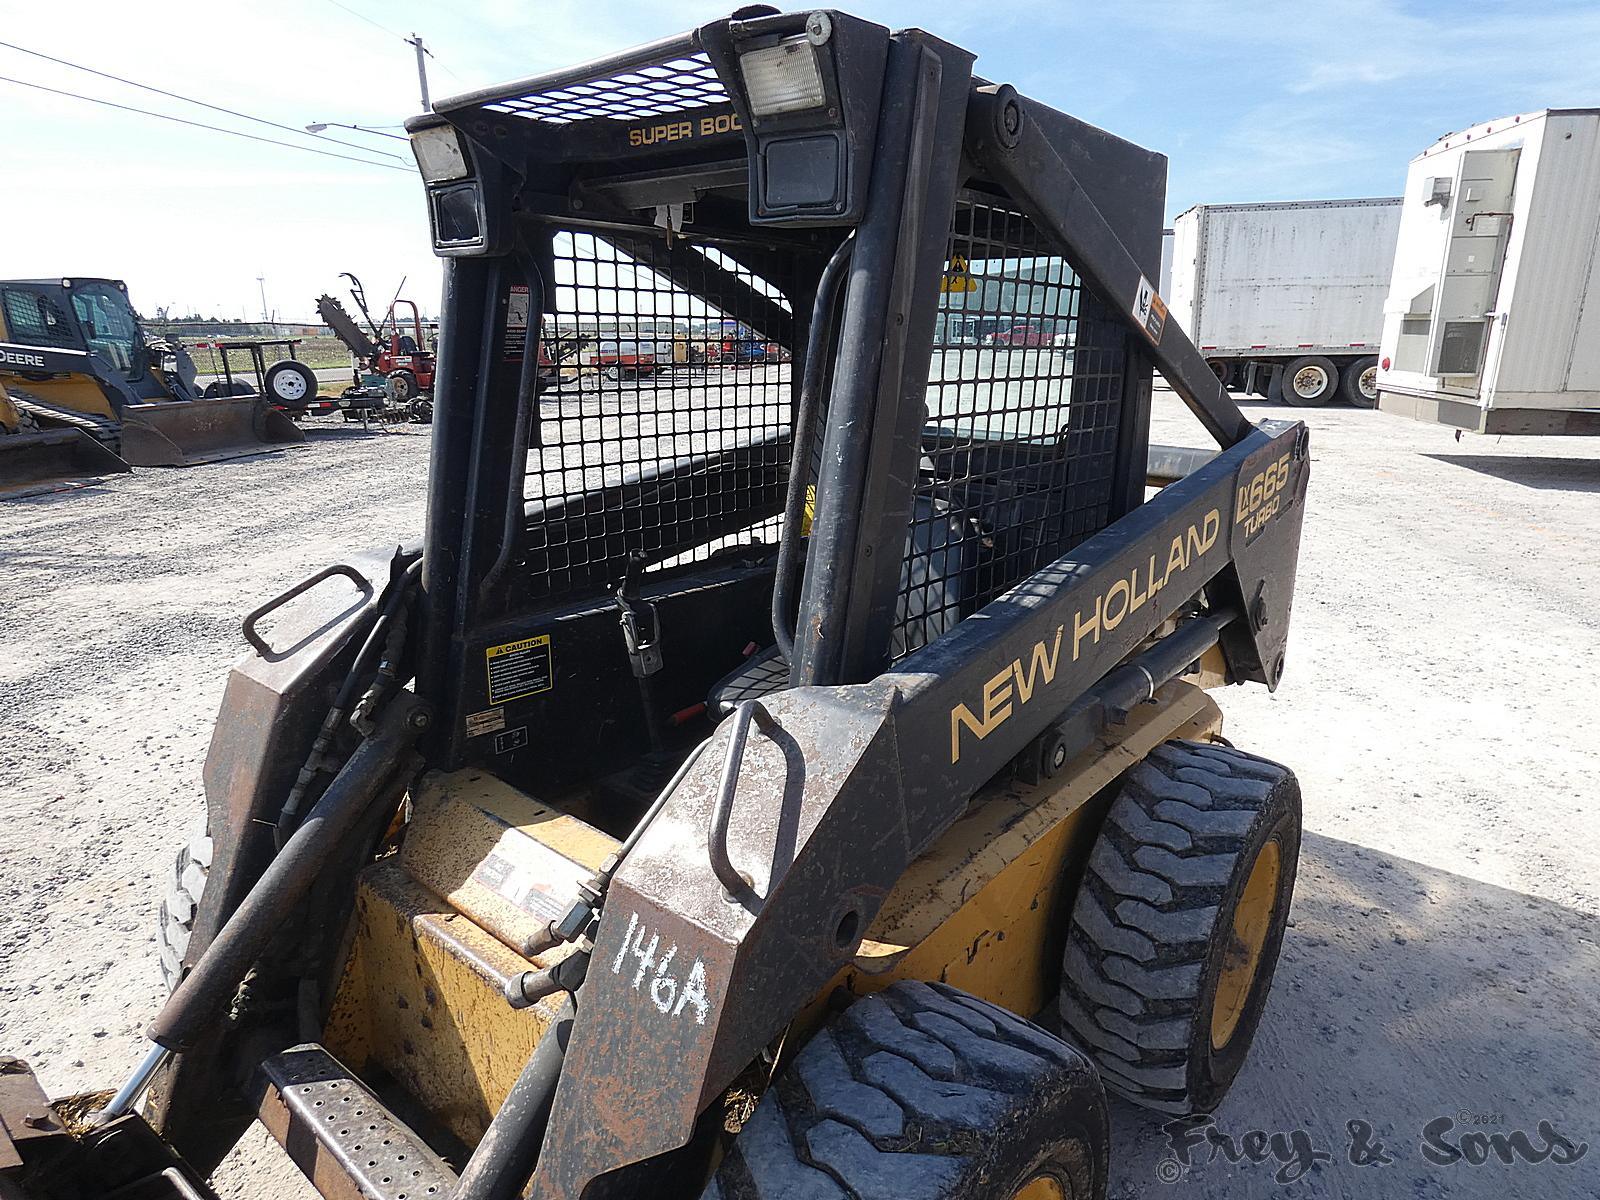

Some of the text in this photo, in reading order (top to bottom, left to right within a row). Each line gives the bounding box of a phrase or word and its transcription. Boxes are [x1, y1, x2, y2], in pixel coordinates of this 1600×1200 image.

[629, 121, 693, 146] SUPER
[1244, 495, 1280, 538] TURBO
[505, 639, 543, 653] CAUTION
[951, 508, 1220, 764] NEW HOLLAND
[612, 911, 711, 1025] 146A
